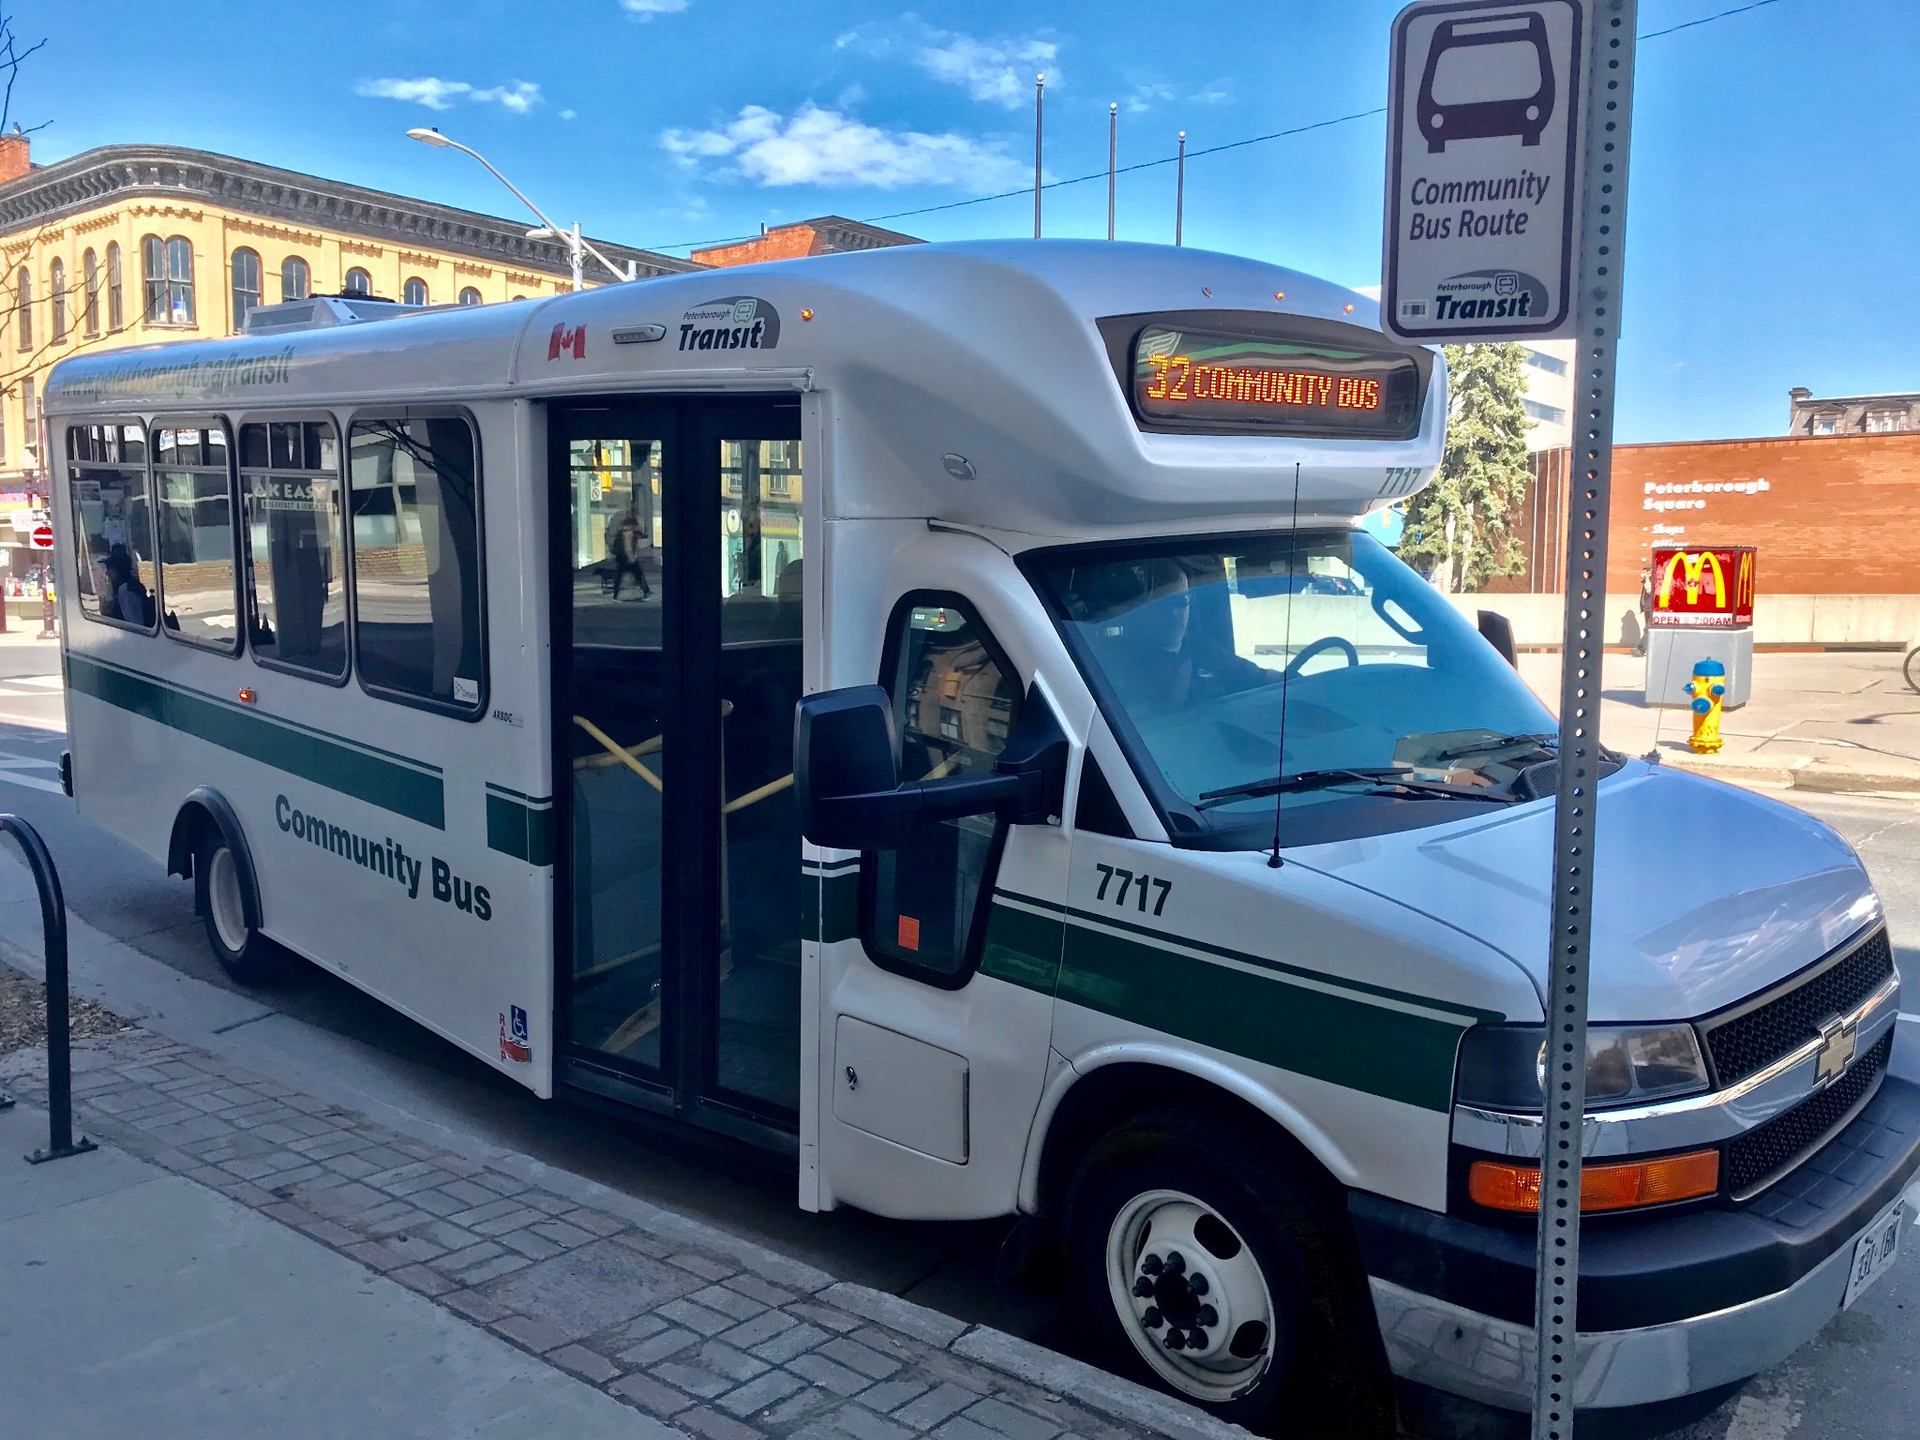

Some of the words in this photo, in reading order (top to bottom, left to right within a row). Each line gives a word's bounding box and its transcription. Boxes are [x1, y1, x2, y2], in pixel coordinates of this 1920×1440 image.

[1411, 169, 1550, 206] Community
[1409, 212, 1451, 241] Bus
[1458, 208, 1529, 238] Route
[1437, 281, 1492, 292] Peterborough
[682, 309, 731, 321] Peterborough
[1436, 292, 1531, 320] Transit
[679, 320, 762, 351] Transit
[1147, 354, 1191, 400] 32
[1193, 366, 1332, 406] COMMUNITY
[1338, 377, 1379, 410] BUS
[1378, 467, 1422, 494] 7717
[1644, 478, 1770, 495] Peterborough
[1643, 498, 1706, 513] Square
[1653, 616, 1681, 625] OPEN
[275, 794, 422, 900] Community
[431, 856, 492, 922] Bus
[1096, 862, 1172, 917] 7717
